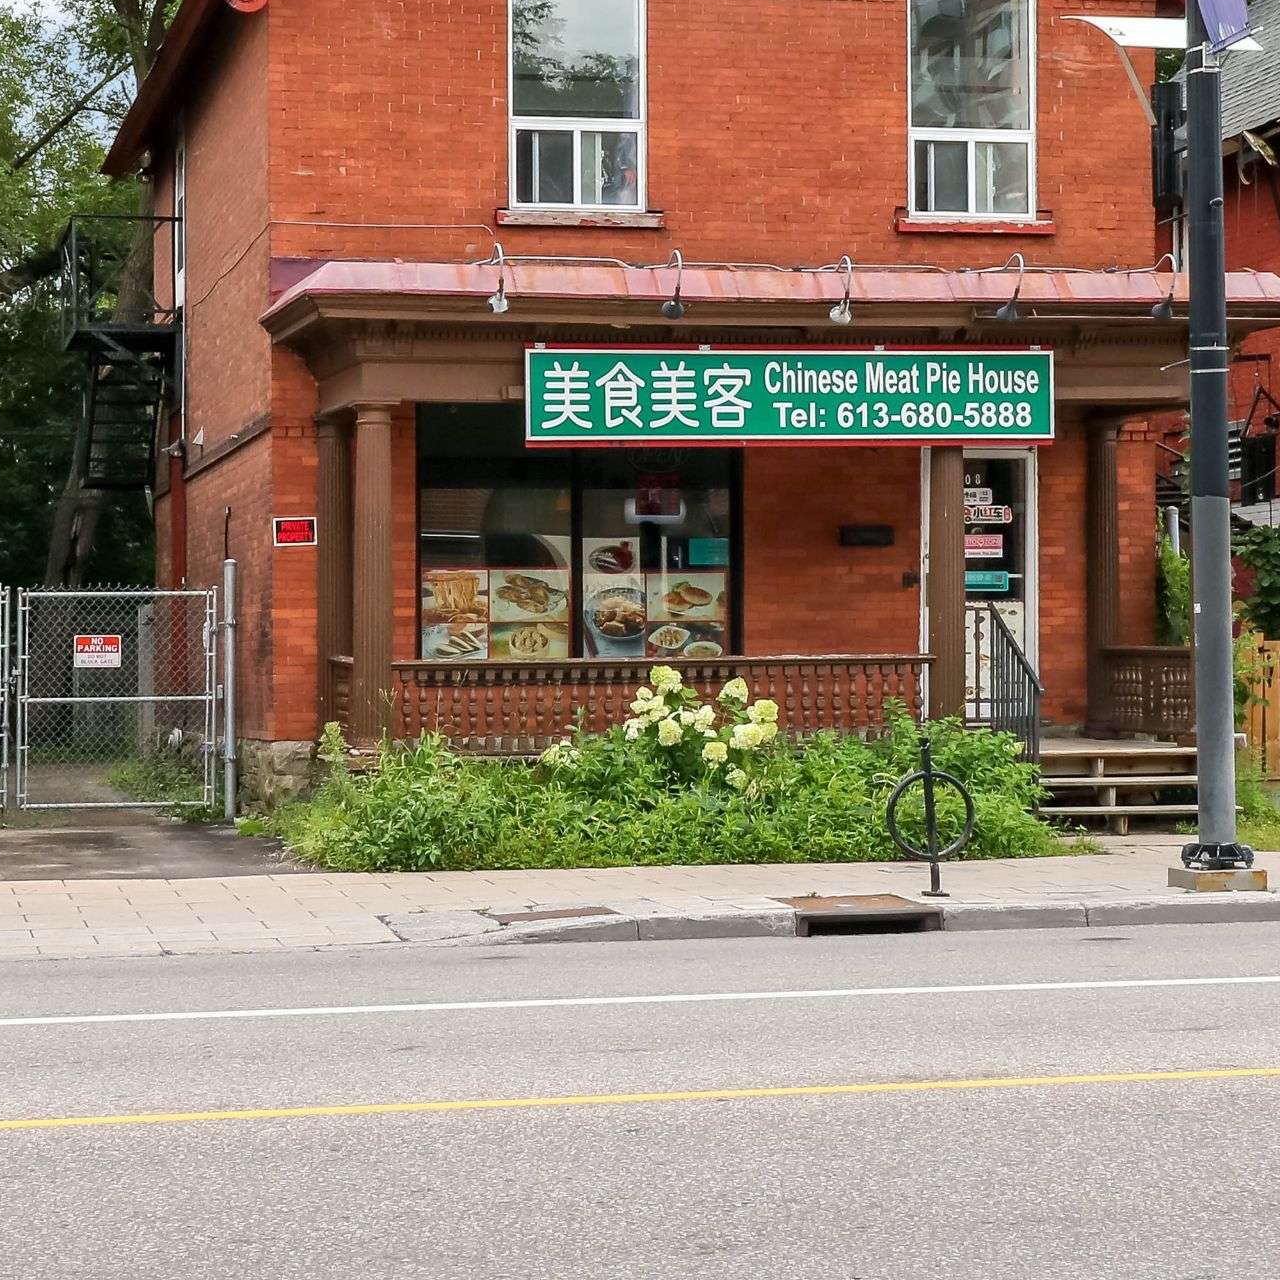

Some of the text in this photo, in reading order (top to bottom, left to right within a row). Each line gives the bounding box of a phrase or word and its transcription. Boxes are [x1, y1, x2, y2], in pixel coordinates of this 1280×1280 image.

[764, 361, 1040, 394] Chinese Meat Pie House
[541, 360, 752, 429] 美食美客
[772, 401, 1032, 428] Tel: 613-680-5888
[91, 637, 104, 645] NO
